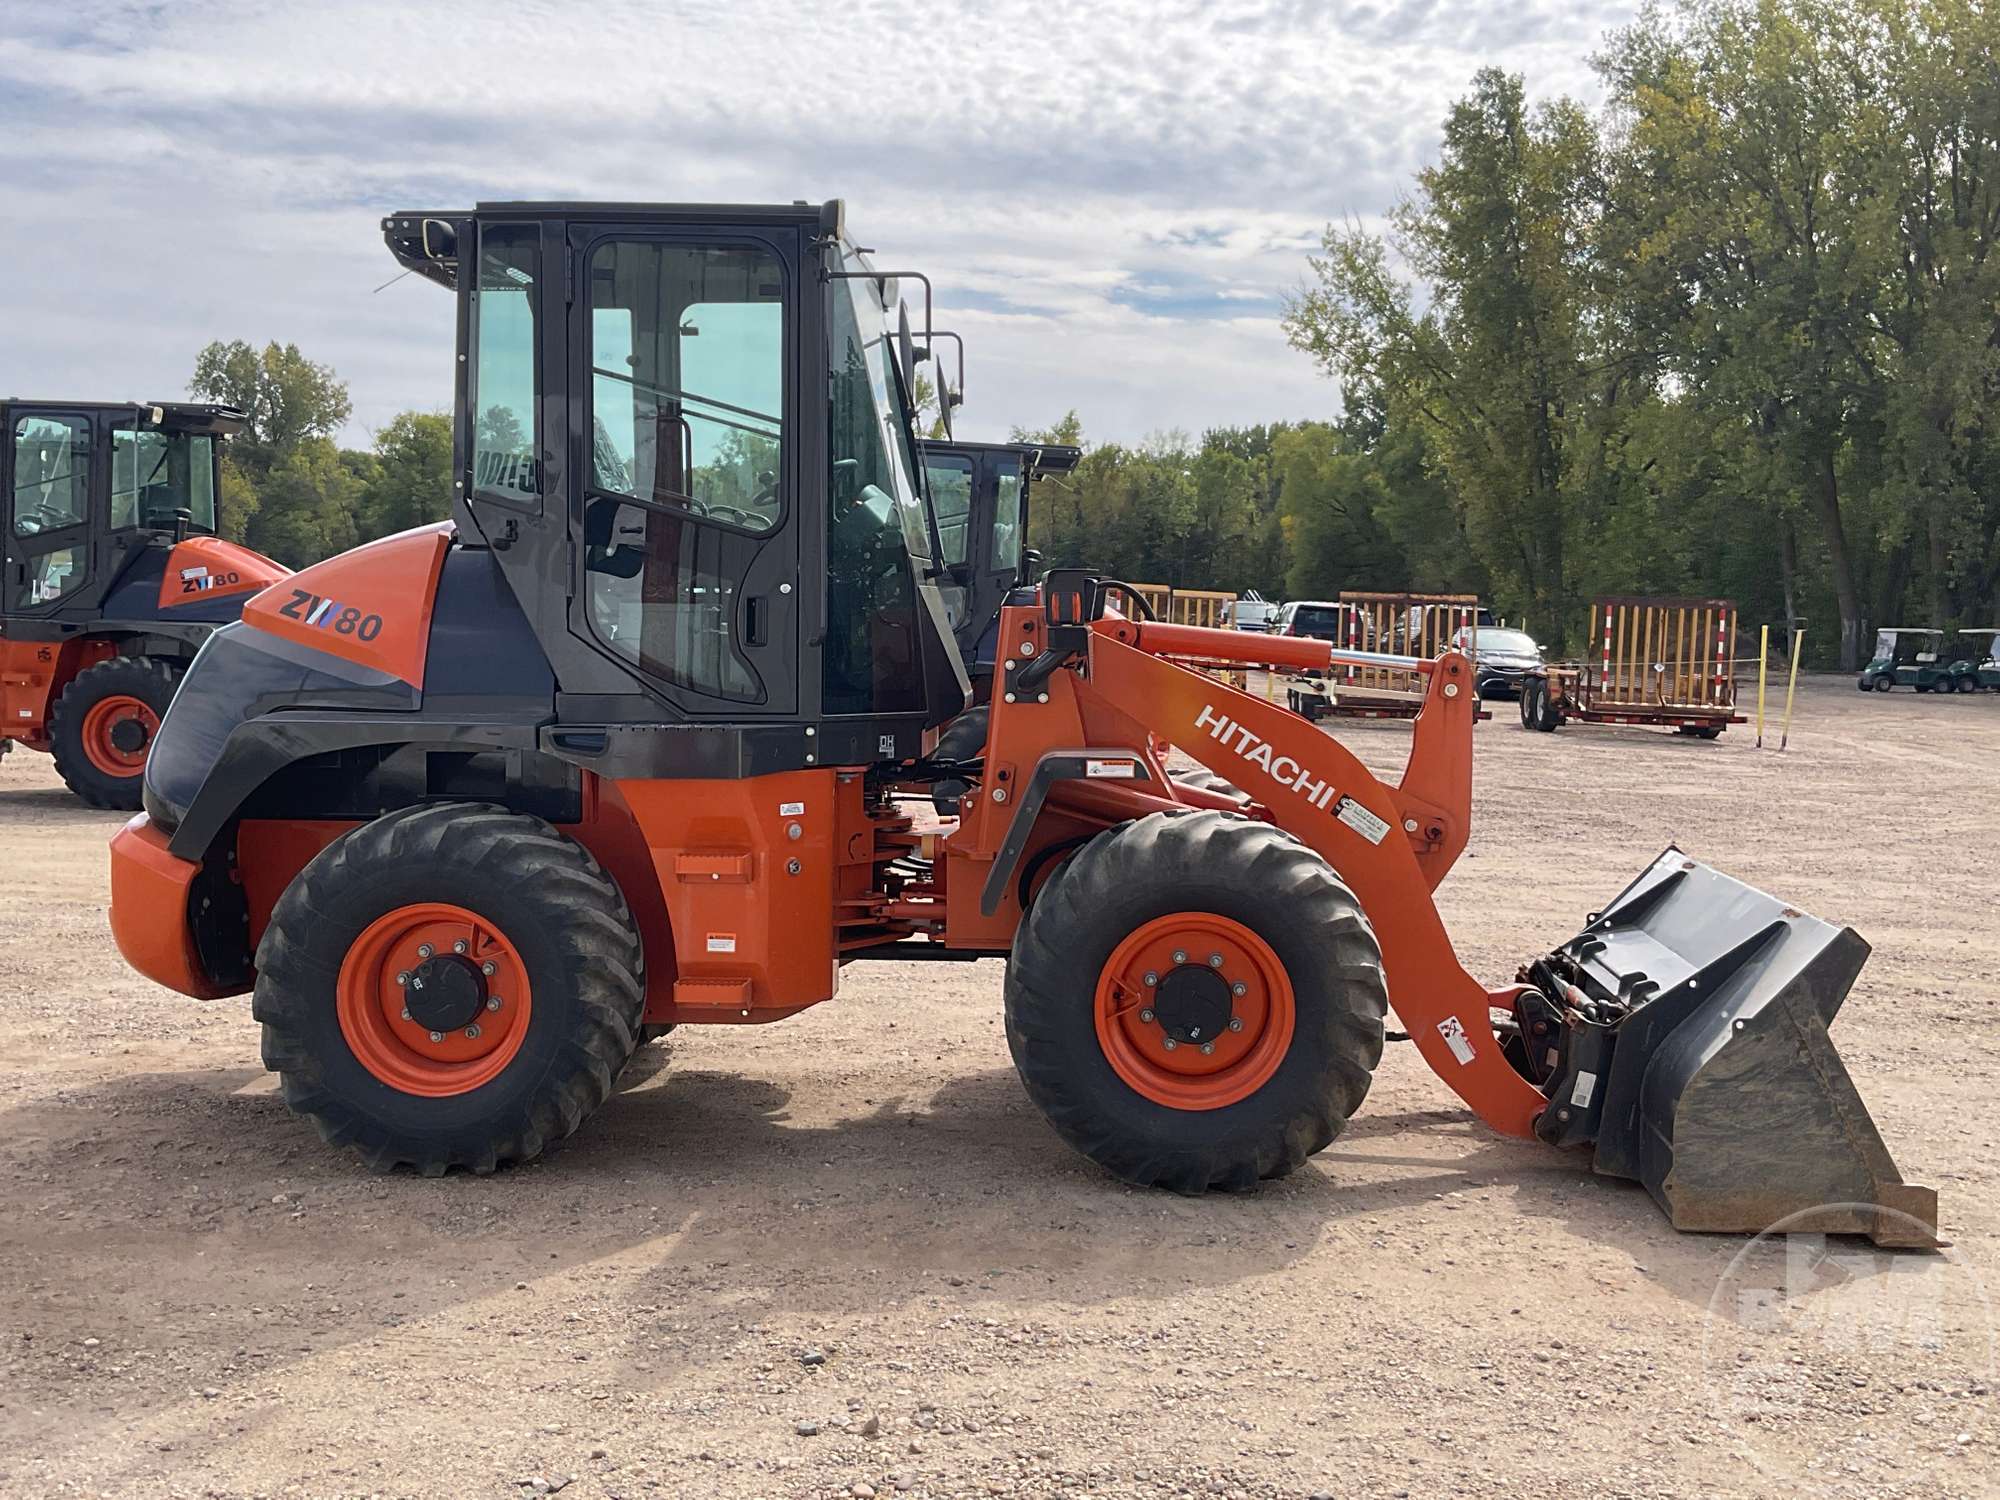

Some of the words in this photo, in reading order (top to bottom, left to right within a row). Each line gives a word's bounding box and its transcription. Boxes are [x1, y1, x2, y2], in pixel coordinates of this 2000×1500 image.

[182, 572, 239, 593] ZW80
[280, 589, 383, 642] ZW80
[1194, 704, 1336, 810] HITACHI
